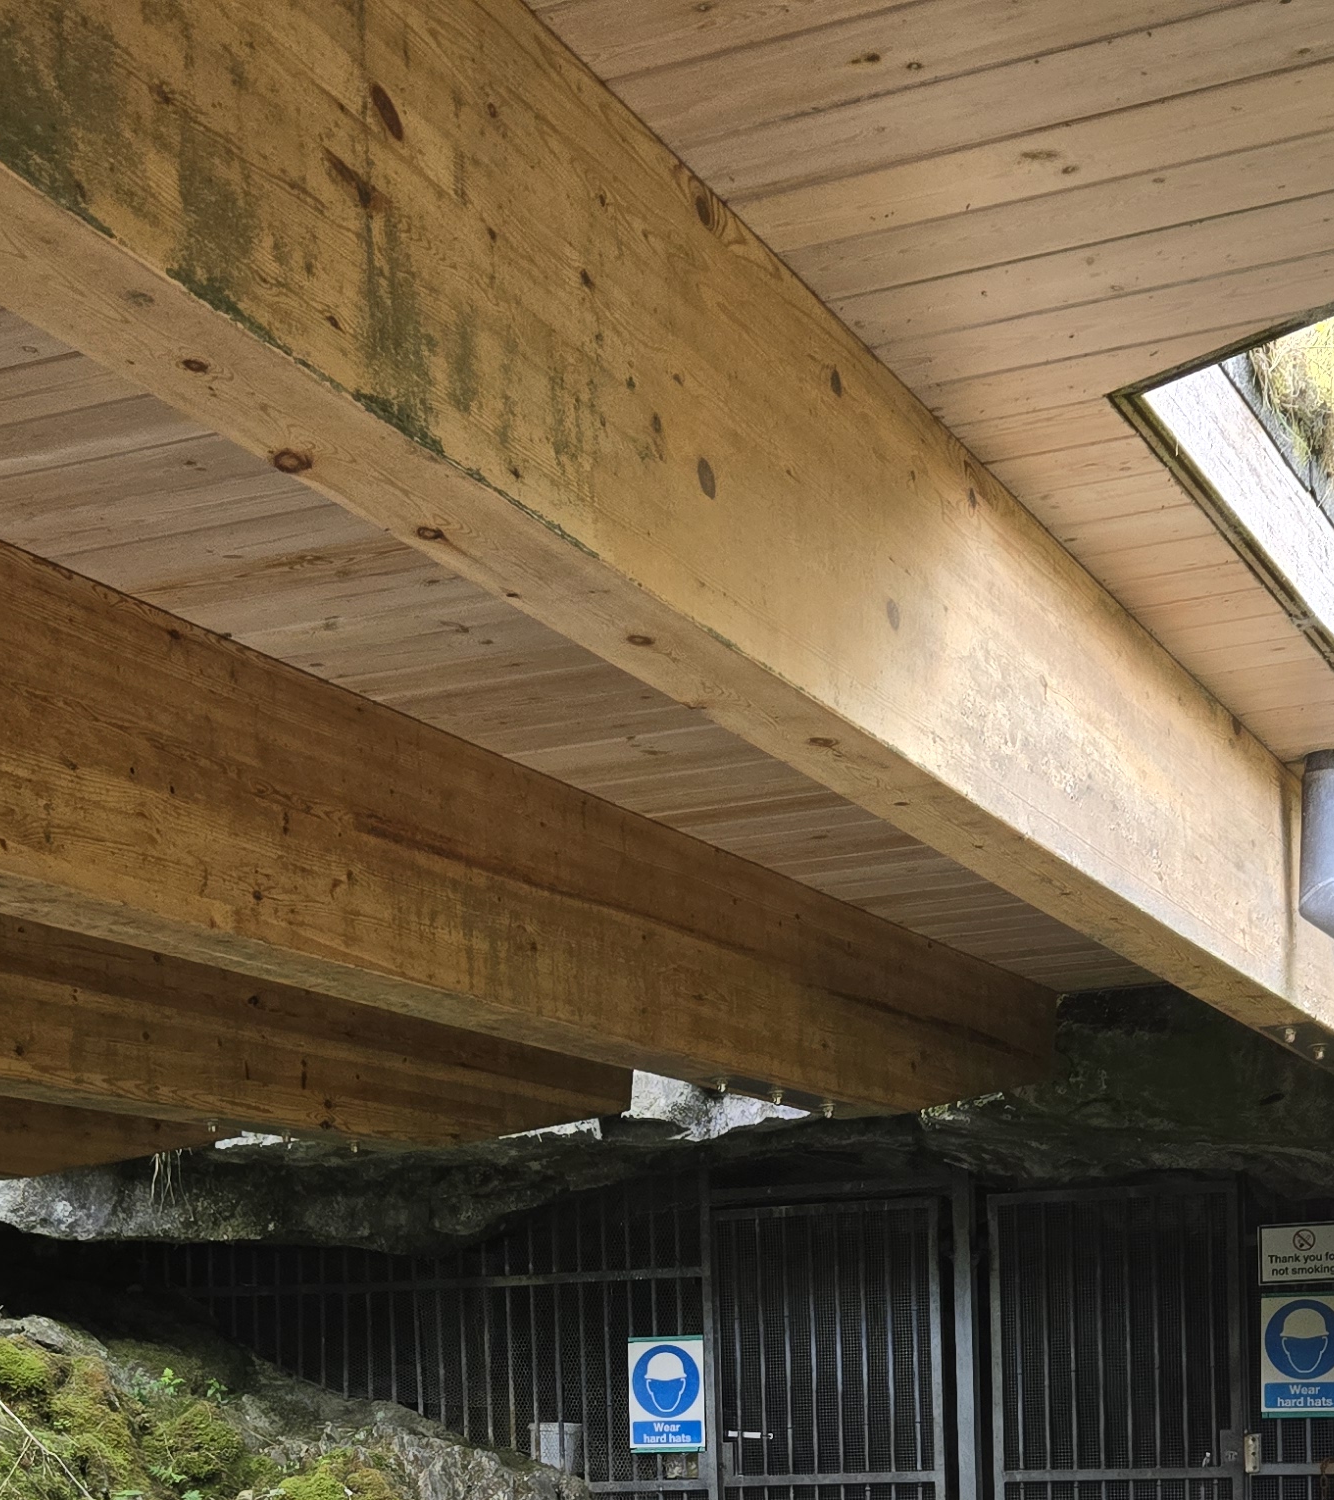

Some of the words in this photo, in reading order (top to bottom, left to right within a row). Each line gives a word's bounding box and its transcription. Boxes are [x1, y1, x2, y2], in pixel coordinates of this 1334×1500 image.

[1268, 1253, 1301, 1264] Thank
[1303, 1253, 1322, 1264] you
[1271, 1267, 1289, 1276] not
[1289, 1384, 1321, 1395] Wear
[1277, 1396, 1304, 1407] hard
[1307, 1396, 1334, 1407] hats
[653, 1422, 681, 1432] Wear
[643, 1433, 667, 1443] hard
[668, 1433, 692, 1443] hats
